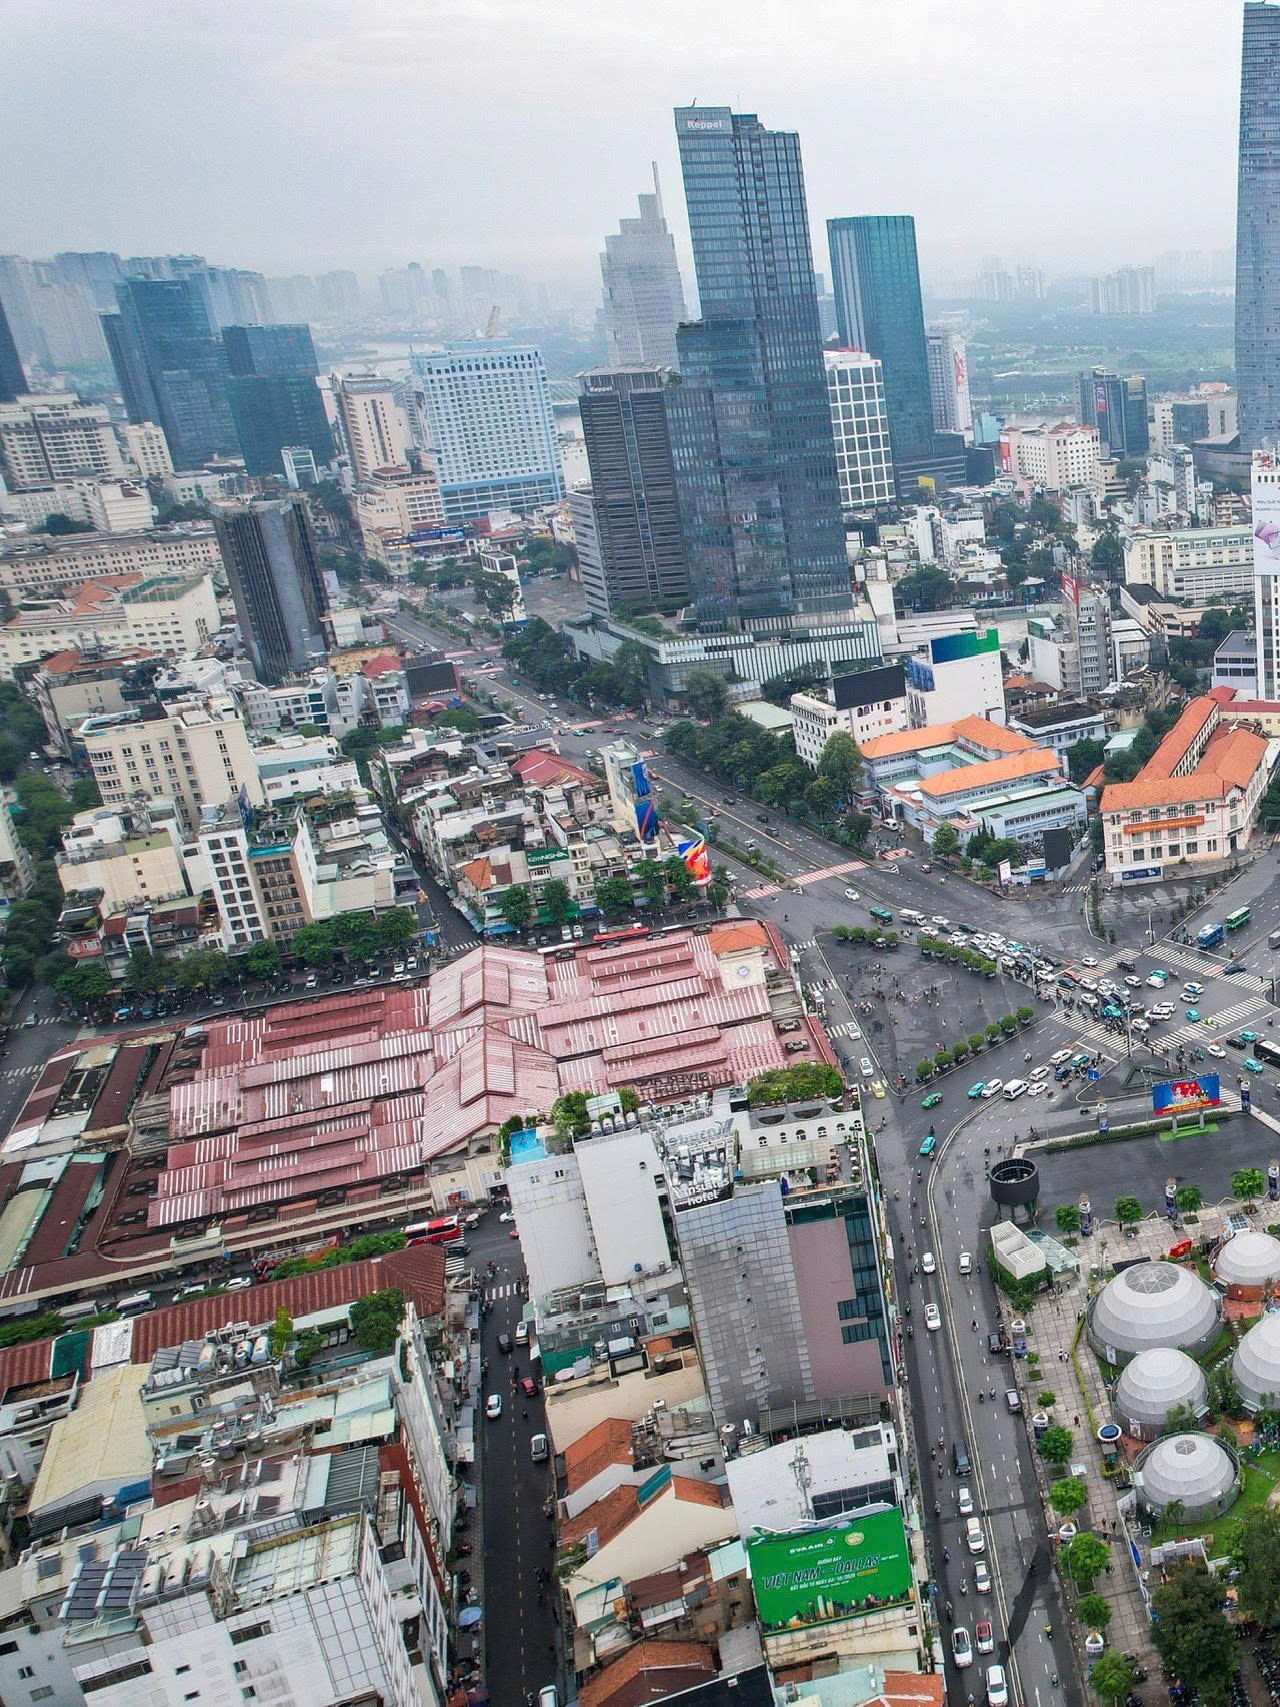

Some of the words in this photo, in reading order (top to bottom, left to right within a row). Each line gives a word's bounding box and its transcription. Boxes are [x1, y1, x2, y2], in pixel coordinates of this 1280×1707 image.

[687, 120, 722, 129] Keppel
[763, 1572, 791, 1590] VIỆT
[792, 1566, 822, 1583] NAM
[834, 1553, 881, 1574] DALLAS
